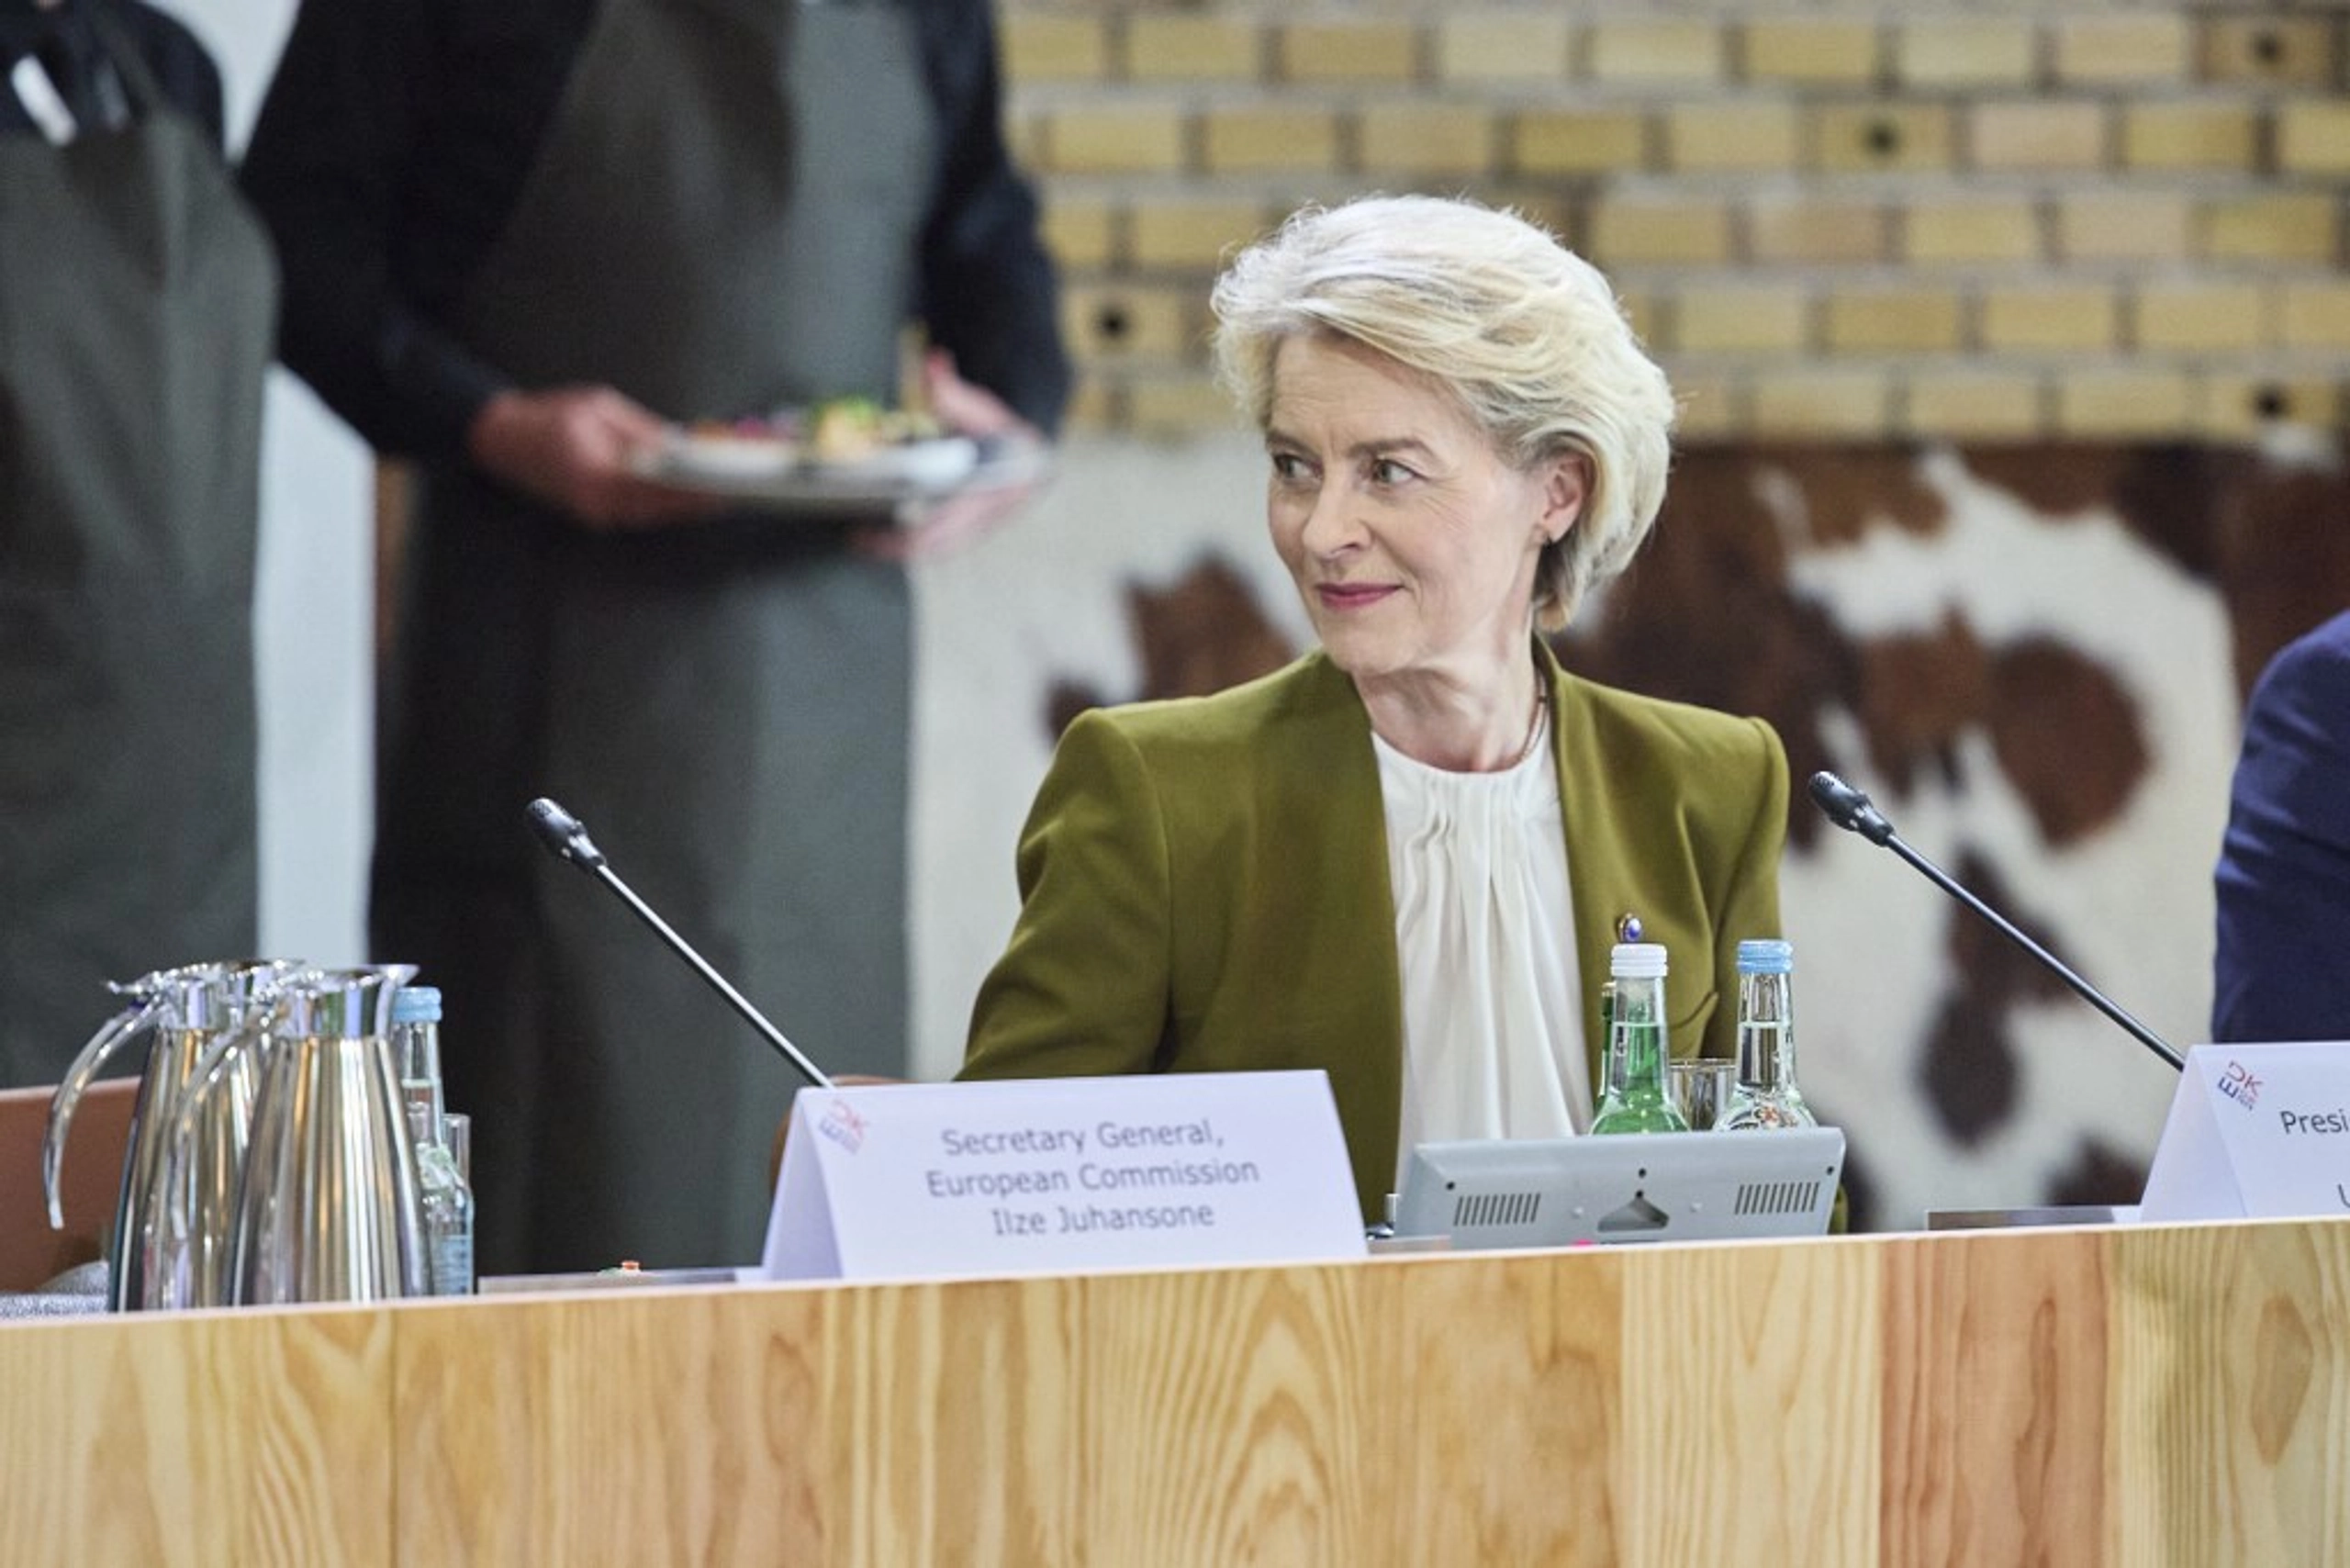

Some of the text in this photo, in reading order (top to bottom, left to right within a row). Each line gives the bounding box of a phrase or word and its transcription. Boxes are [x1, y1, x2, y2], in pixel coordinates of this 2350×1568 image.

[941, 1116, 1225, 1157] Secretary General,
[925, 1157, 1261, 1202] European Commission
[991, 1204, 1216, 1236] Ilze Juhansone
